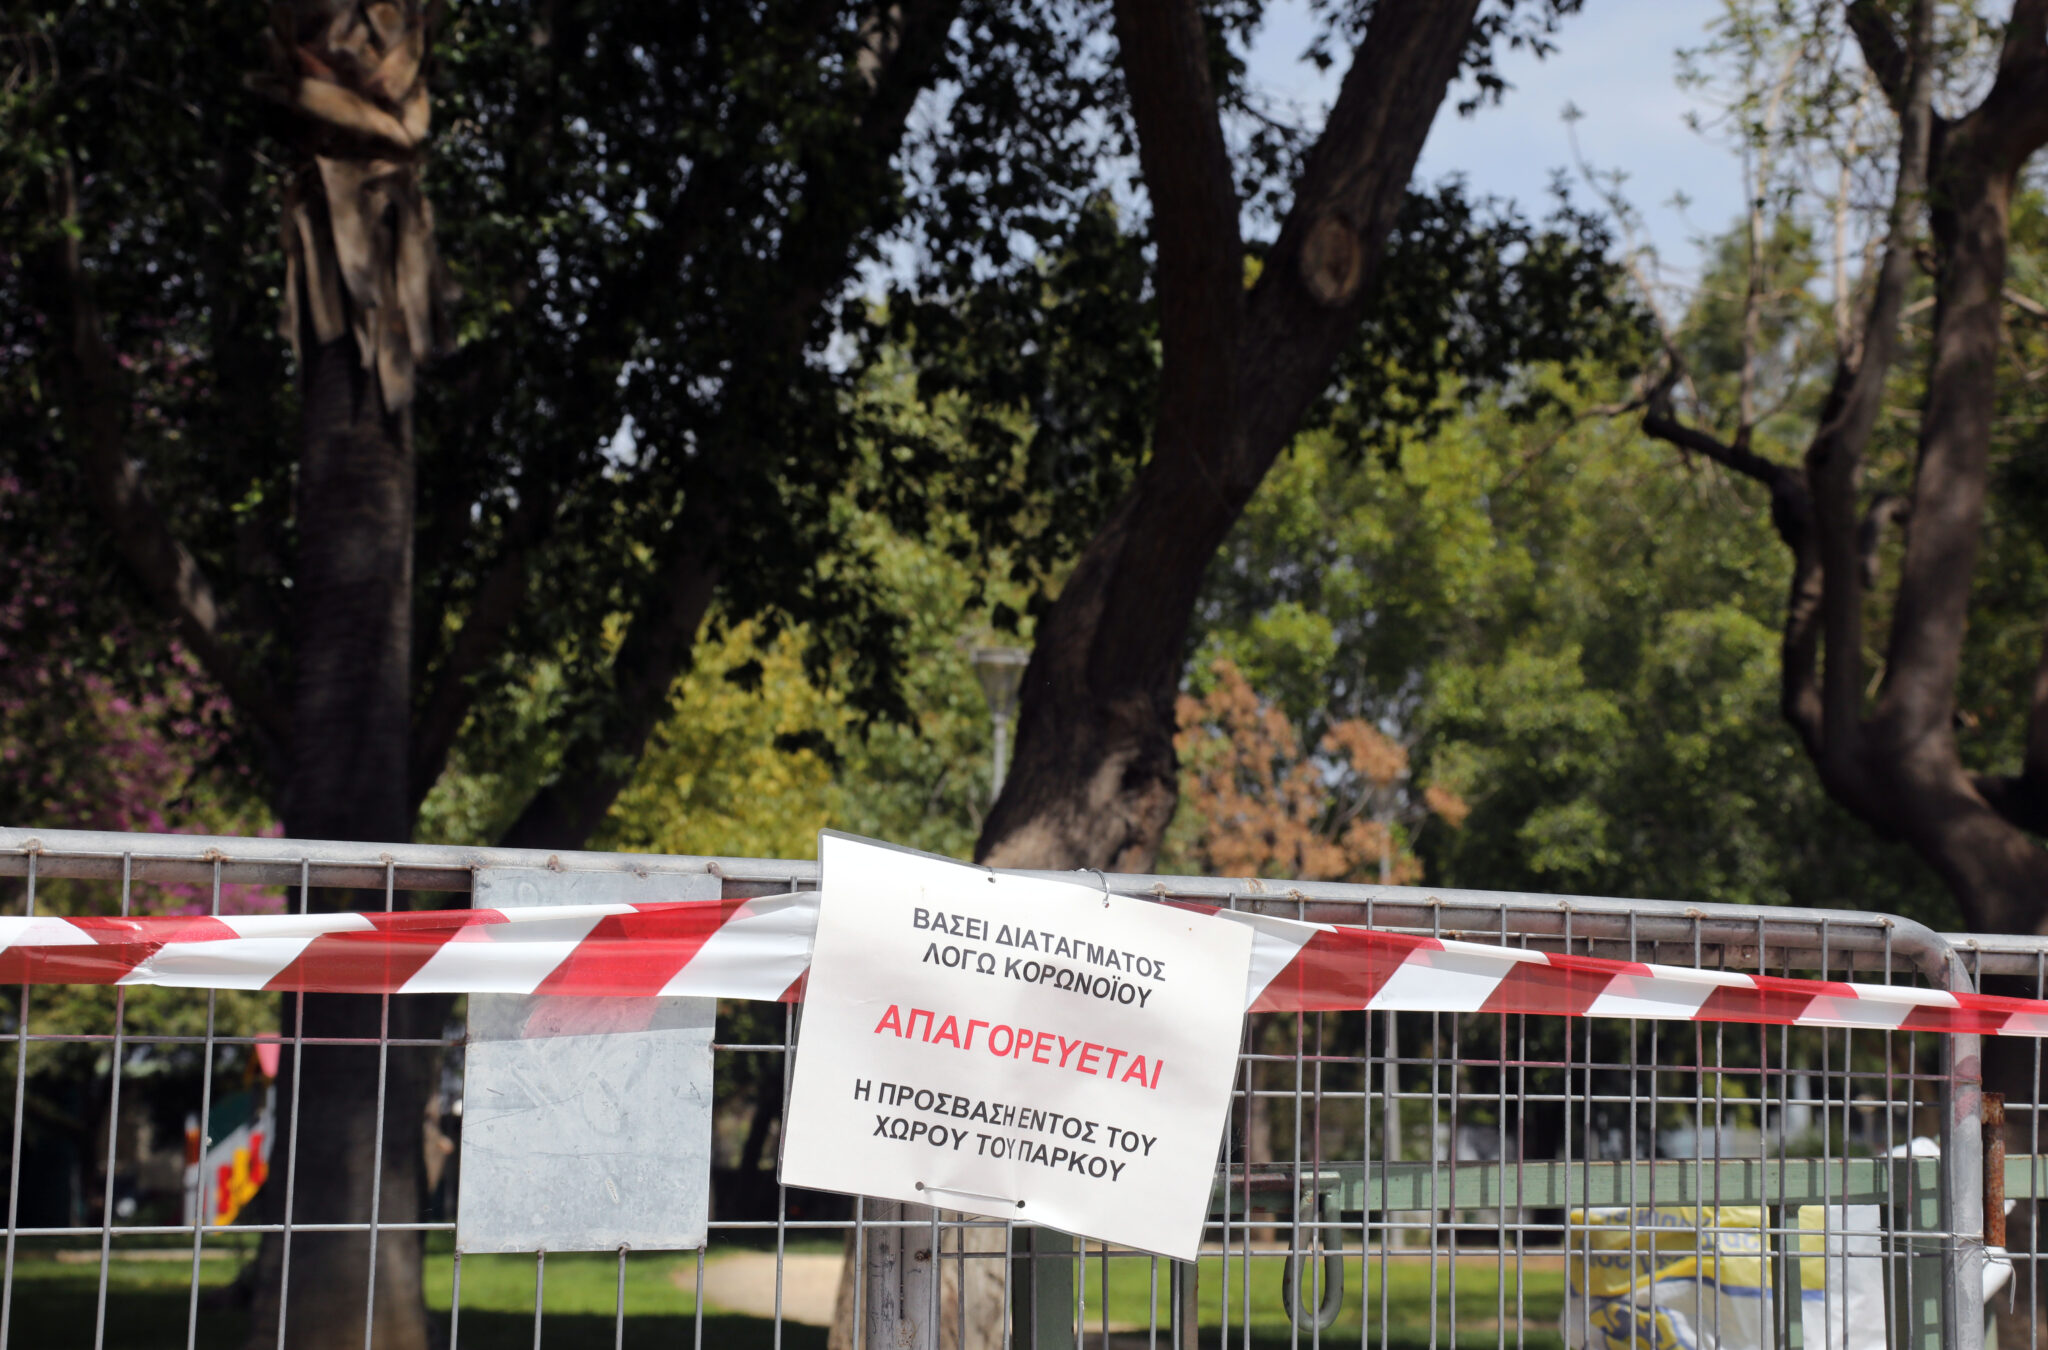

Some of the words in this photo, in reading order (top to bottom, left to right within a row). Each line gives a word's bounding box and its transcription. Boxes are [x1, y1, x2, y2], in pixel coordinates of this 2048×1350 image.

[913, 908, 988, 942] ΒΑΣΕΙ
[995, 925, 1166, 982] ΔΙΑΤΑΓΜΑΤΟΣ
[923, 943, 996, 976] ΛΟΓΩ
[1004, 957, 1152, 1009] ΚΟΡΩΝΟΪΟΥ
[874, 1004, 1164, 1091] ΑΠΑΓΟΡΕΥΕΤΑΙ
[854, 1079, 872, 1102] Η
[878, 1082, 1016, 1127] ΠΡΟΣΒΑΣΗ
[1018, 1107, 1099, 1145] ΕΝΤΟΣ
[1107, 1126, 1157, 1157] ΤΟΥ
[873, 1115, 969, 1151] ΧΩΡΟΥ
[977, 1133, 1016, 1160] ΤΟΥ
[1018, 1140, 1126, 1183] ΠΑΡΚΟΥ
